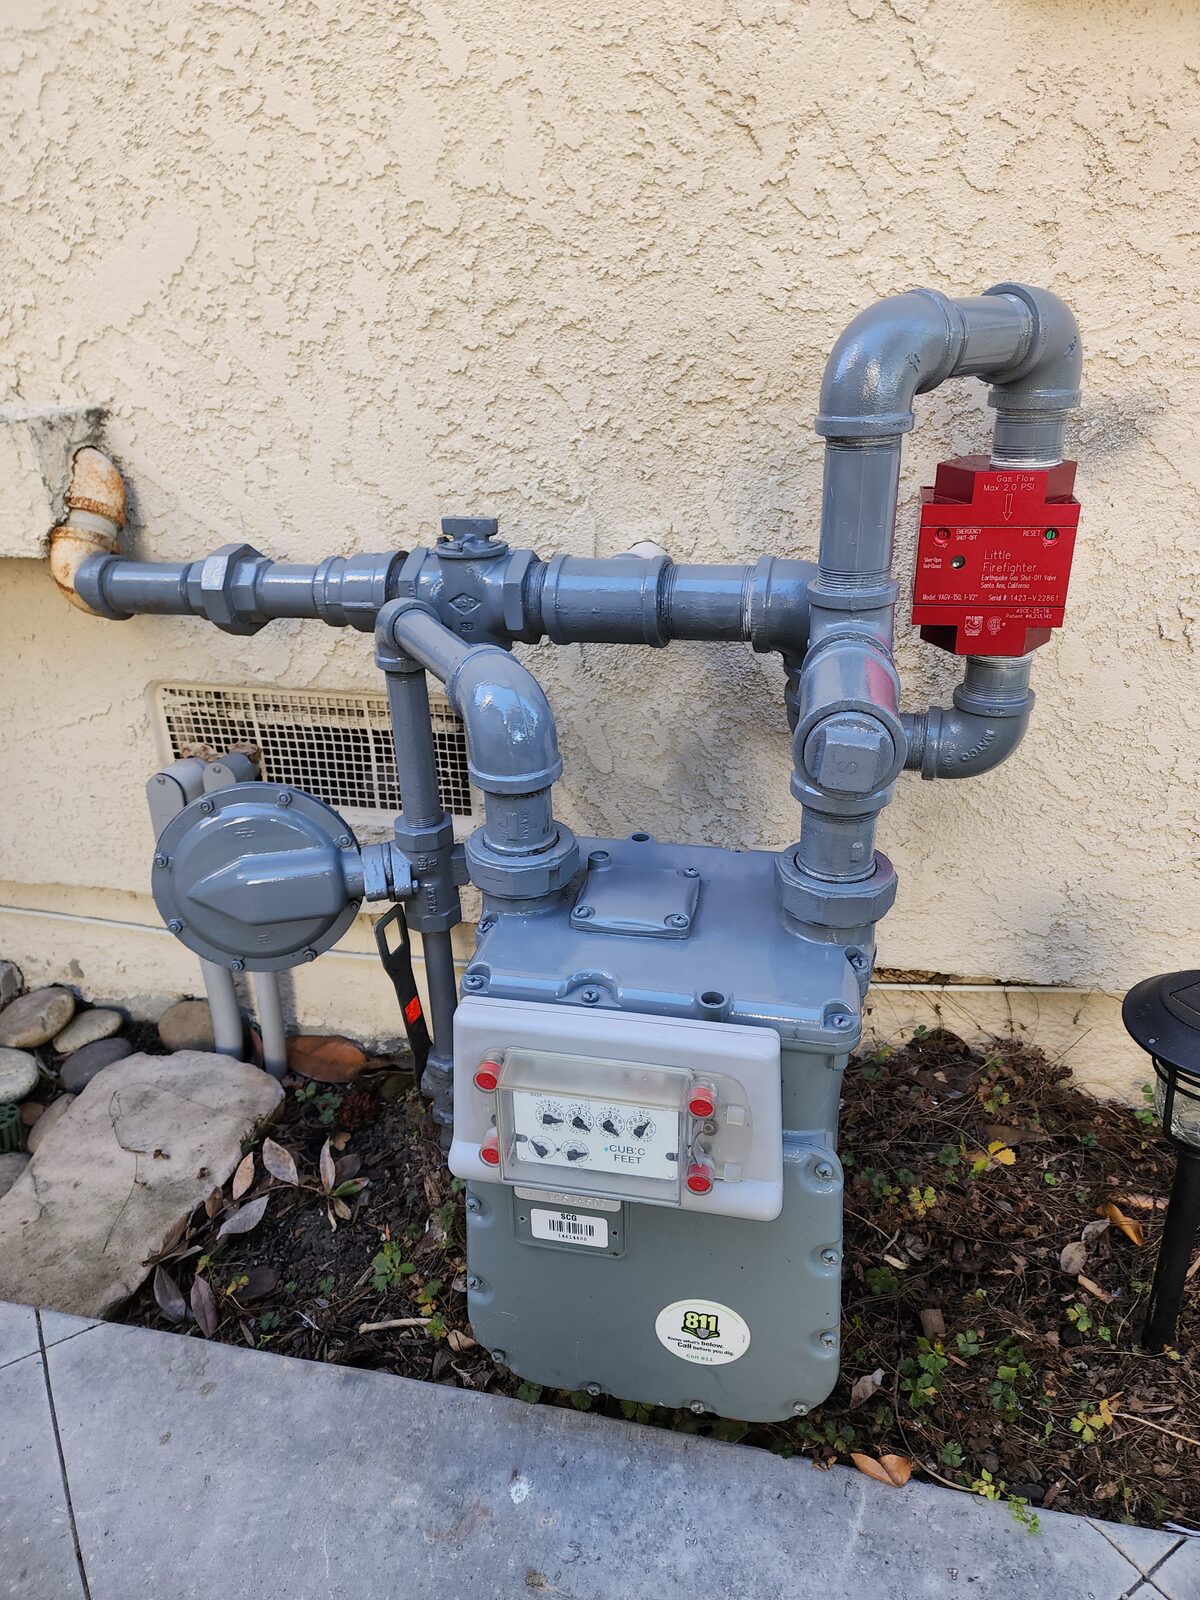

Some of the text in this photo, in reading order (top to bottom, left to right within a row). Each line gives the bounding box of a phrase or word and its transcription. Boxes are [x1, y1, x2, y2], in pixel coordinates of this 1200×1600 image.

[996, 474, 1036, 483] Gas Flow
[983, 484, 1000, 492] Max
[1020, 483, 1035, 491] PSI
[1022, 529, 1041, 537] RESET
[984, 550, 1012, 560] Little
[982, 562, 1038, 575] Firefighter
[981, 574, 1008, 582] Earthquake
[1020, 574, 1042, 582] Shut-Off
[613, 1154, 642, 1165] FEET
[560, 1213, 577, 1222] SCG
[684, 1311, 718, 1332] 811
[677, 1341, 692, 1349] Call
[693, 1345, 712, 1353] before
[701, 1341, 724, 1349] below.
